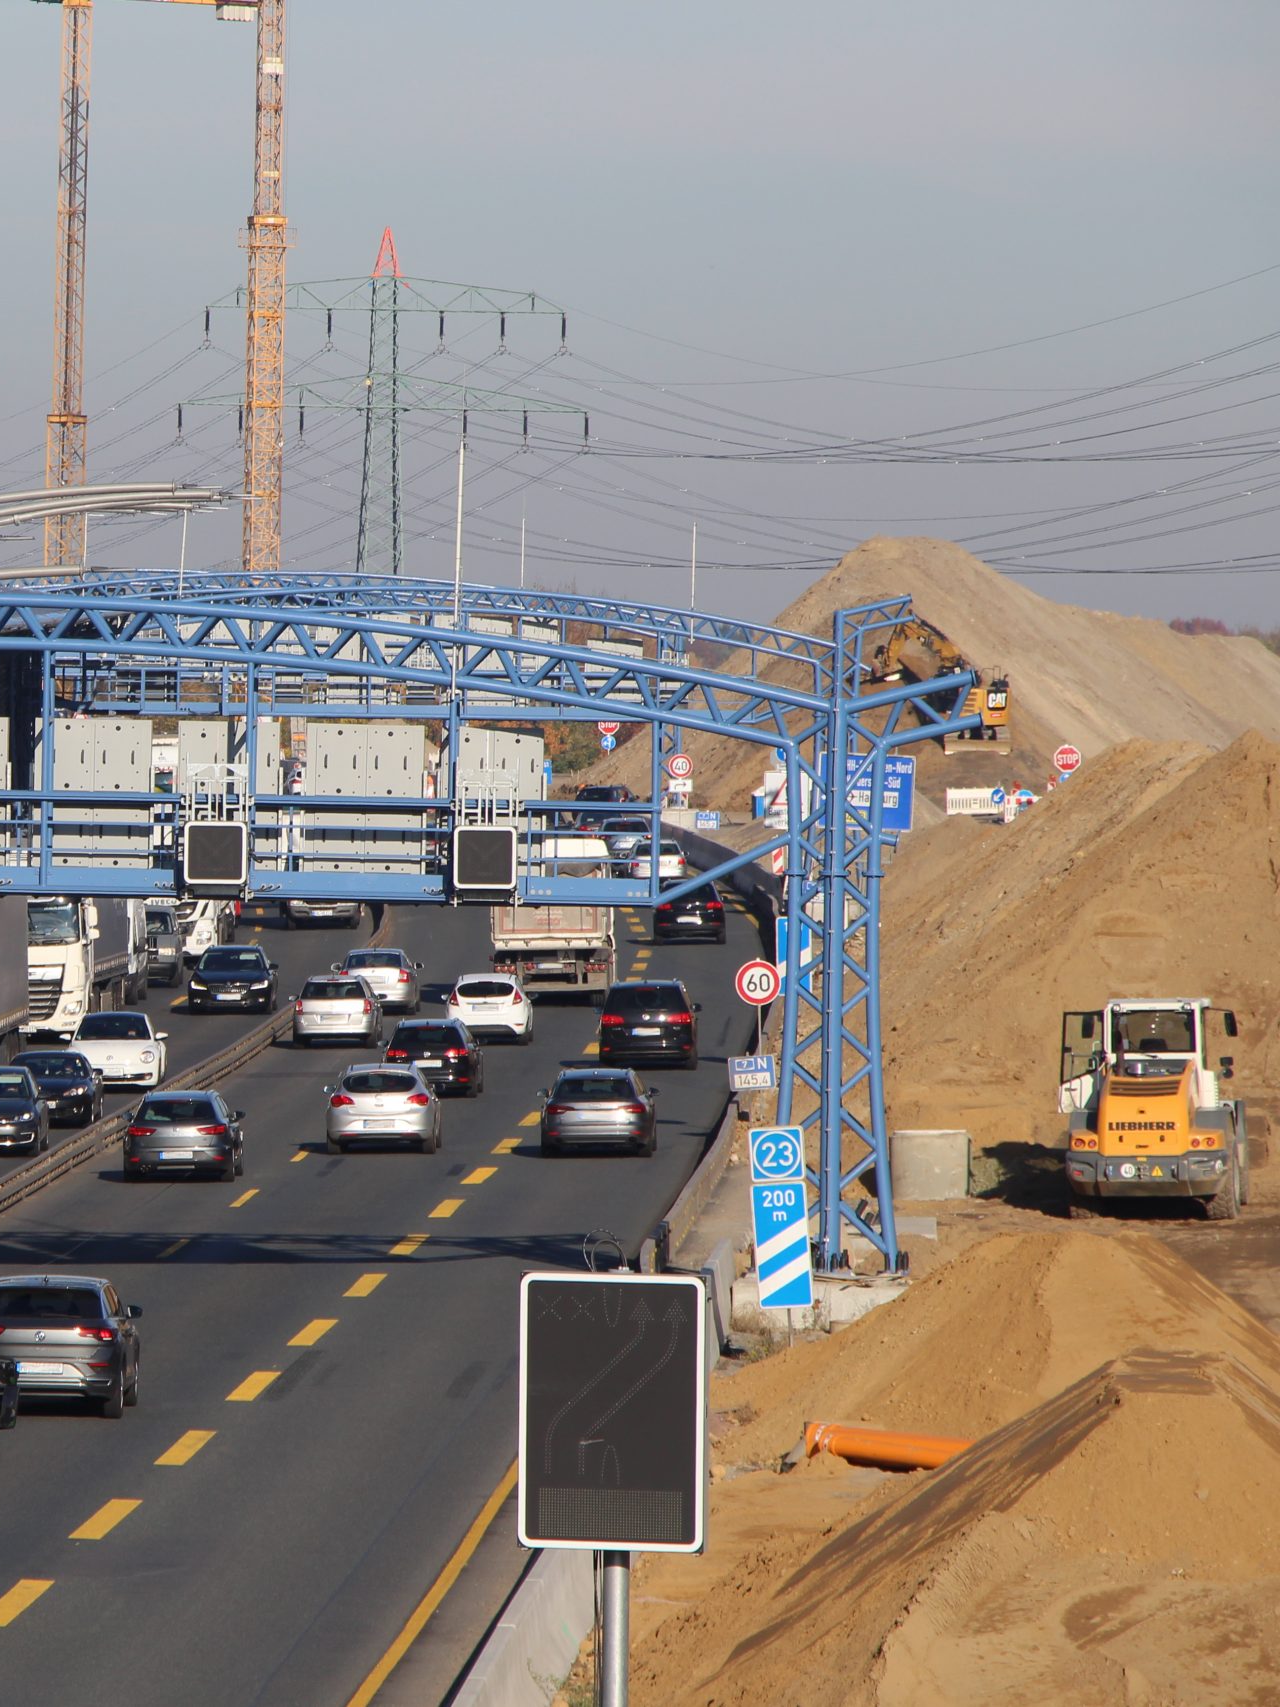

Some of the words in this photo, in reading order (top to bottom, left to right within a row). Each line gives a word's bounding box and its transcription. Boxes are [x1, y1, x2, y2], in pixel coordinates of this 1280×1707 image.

[988, 693, 1007, 708] CAT
[674, 760, 689, 771] 40
[1057, 753, 1080, 765] STOP
[746, 973, 771, 992] 60
[757, 1057, 768, 1070] N
[1108, 1121, 1176, 1131] LIEBHERR
[761, 1141, 794, 1168] 23
[762, 1190, 796, 1208] 200
[772, 1210, 788, 1222] m
